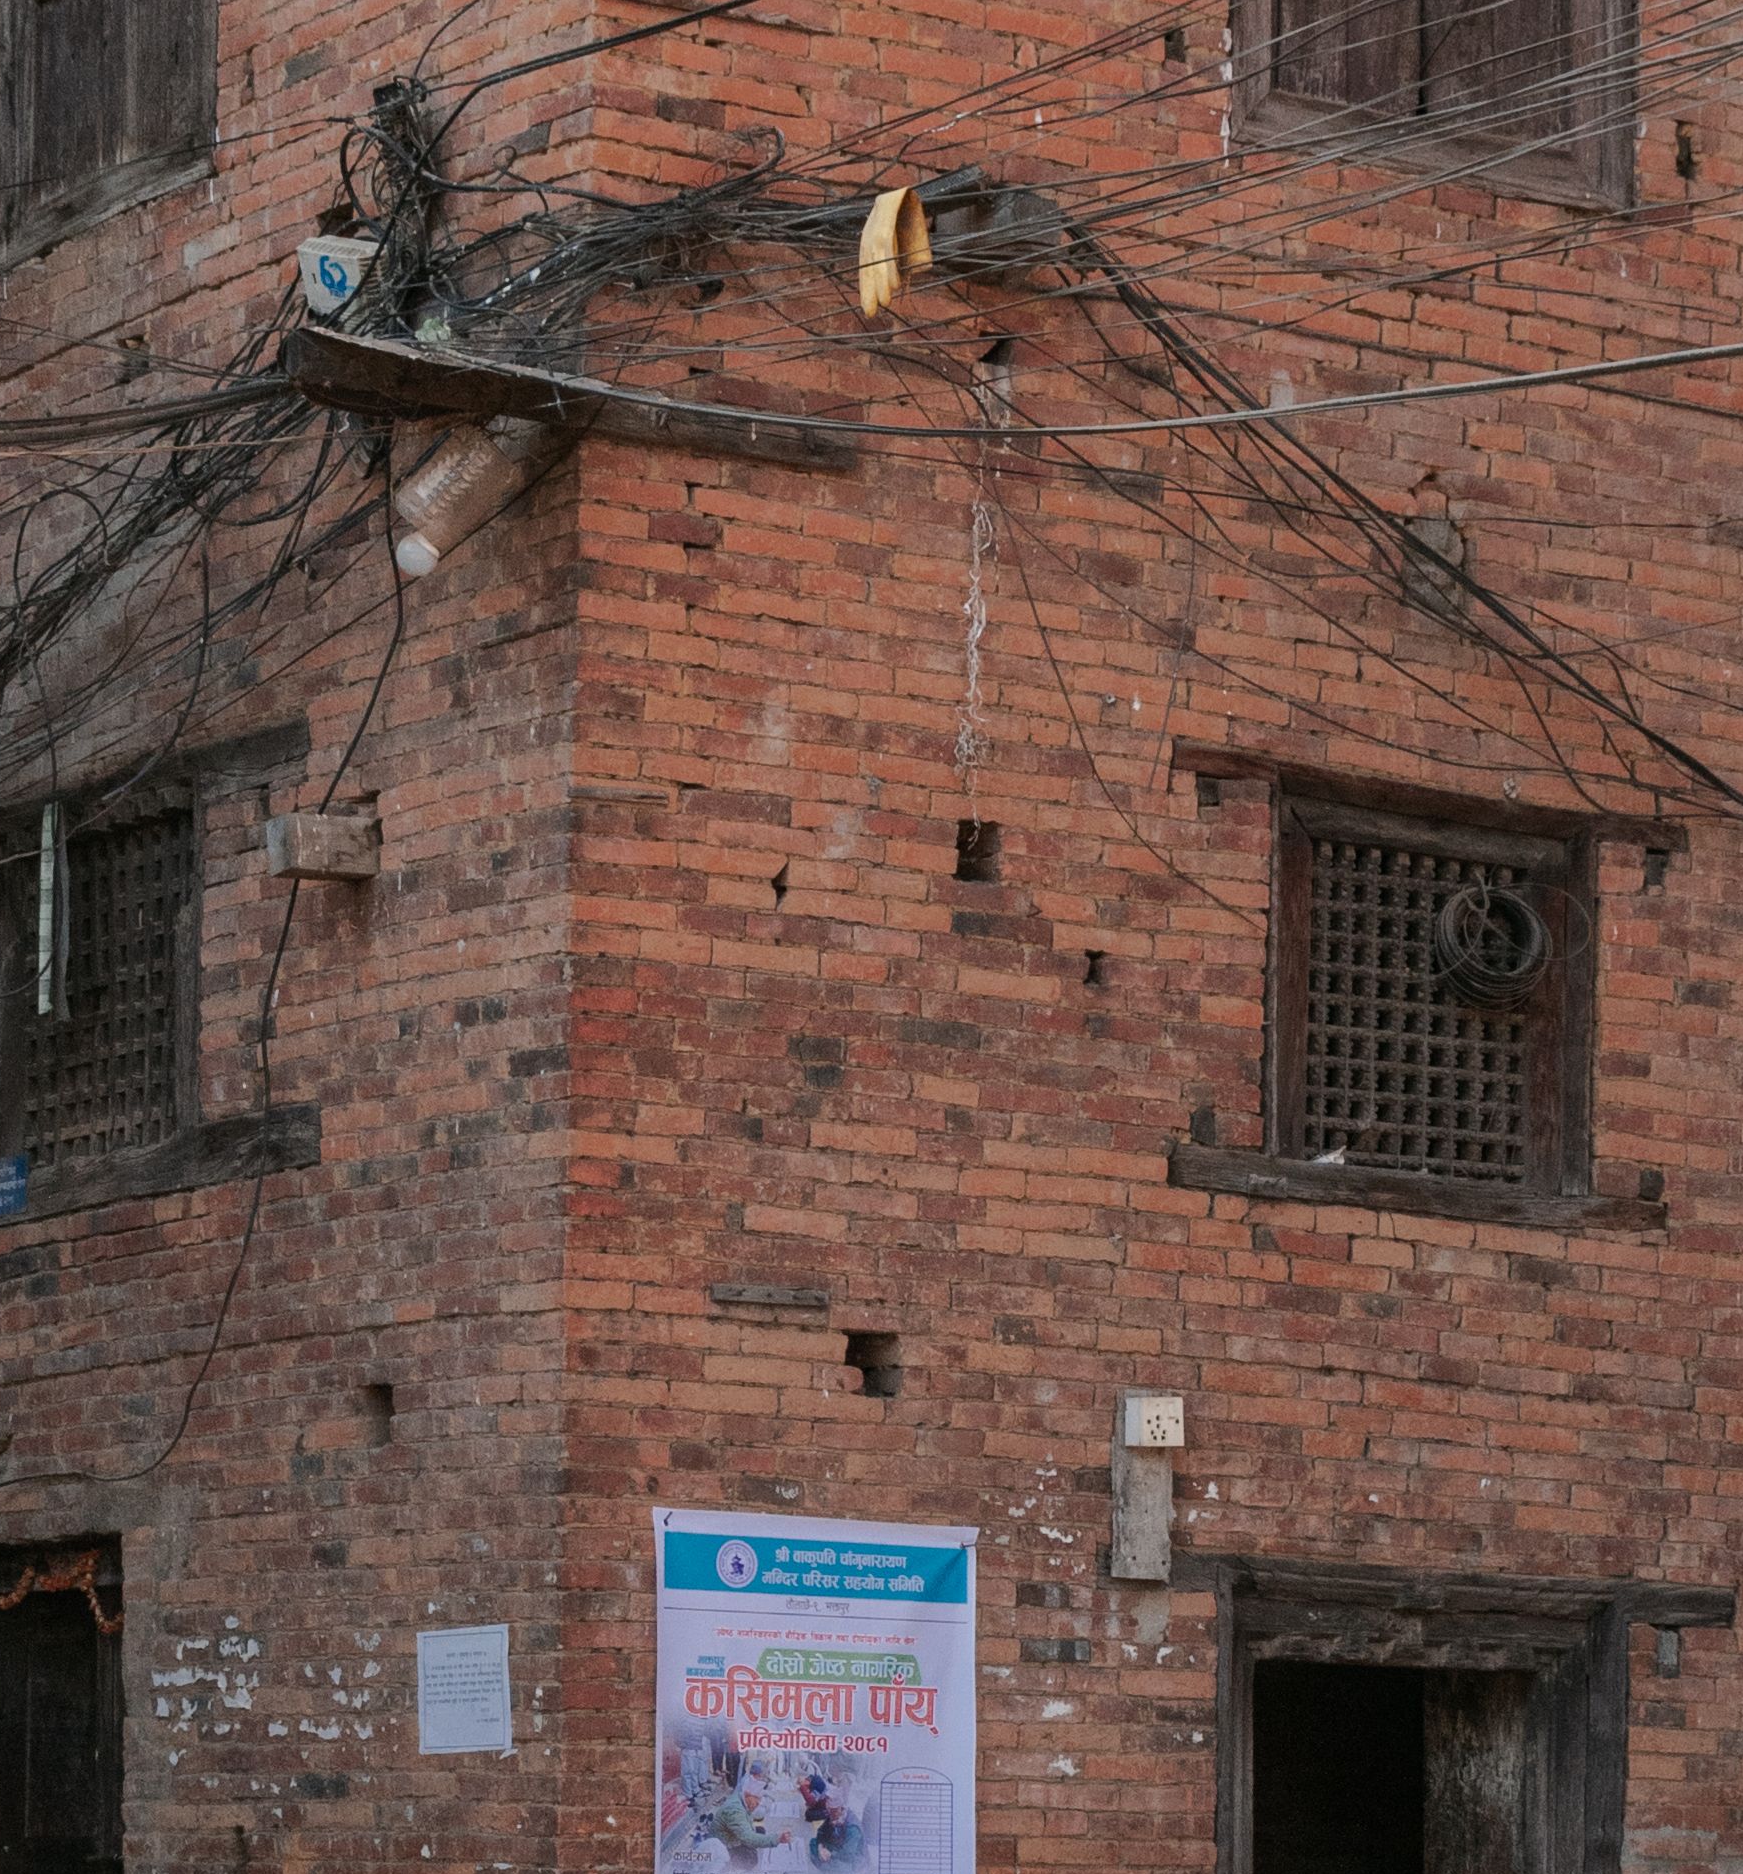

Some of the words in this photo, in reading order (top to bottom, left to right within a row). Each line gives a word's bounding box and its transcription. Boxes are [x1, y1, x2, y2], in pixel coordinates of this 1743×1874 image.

[775, 1545, 789, 1563] श्री
[793, 1546, 835, 1568] वाकुपति
[762, 1567, 797, 1586] मन्दिर
[802, 1569, 840, 1589] परिसर
[843, 1572, 883, 1591] सहयोग
[888, 1574, 924, 1593] समिति
[825, 1601, 849, 1615] भक्तपुर
[766, 1650, 804, 1675] दोस्रो
[809, 1652, 846, 1676] जेष्ठ
[850, 1655, 914, 1680] नागरिक
[684, 1662, 857, 1726] कसिमला
[673, 1850, 711, 1863] कार्यक्रम
